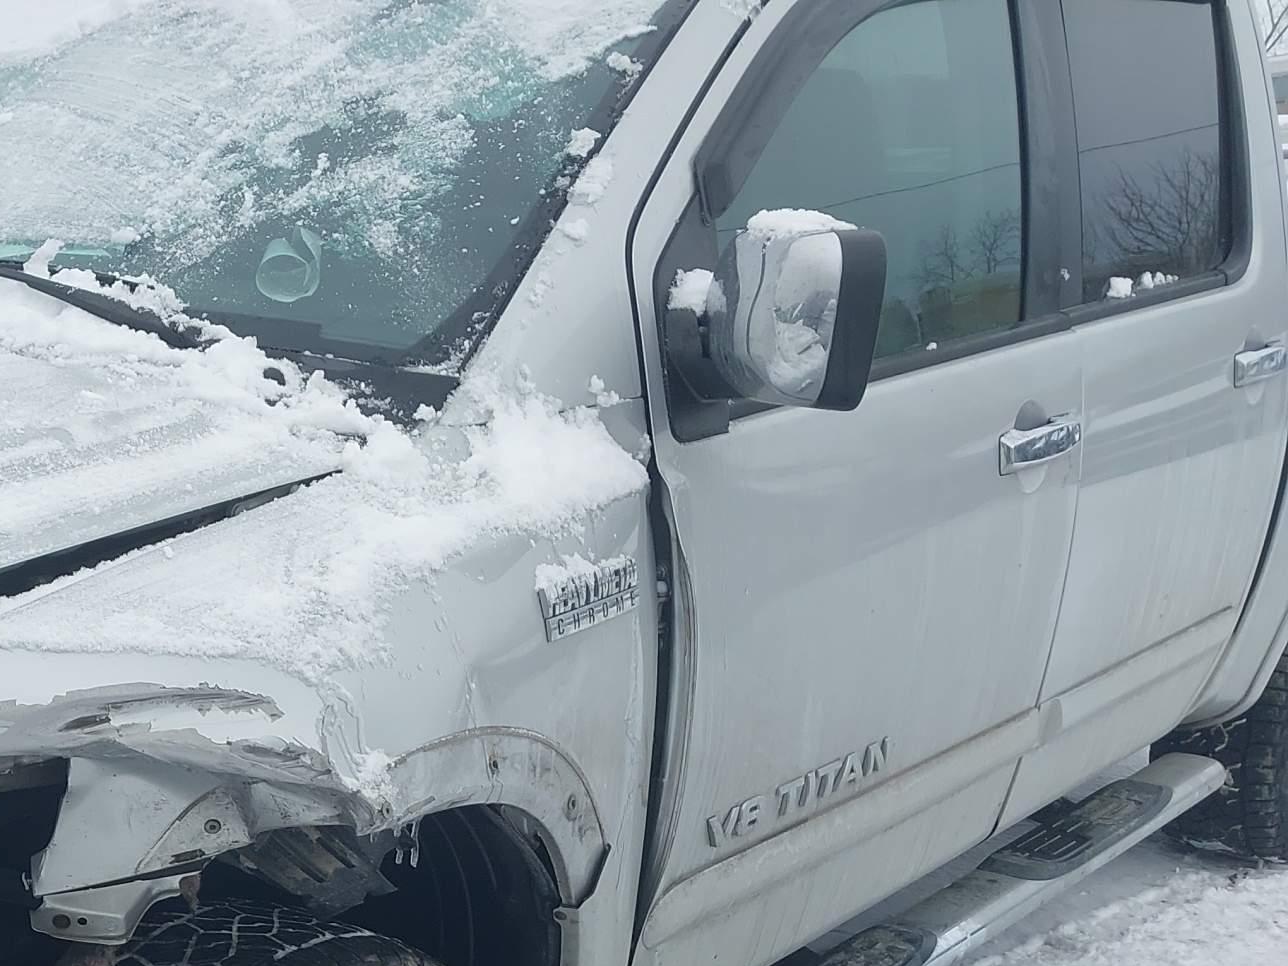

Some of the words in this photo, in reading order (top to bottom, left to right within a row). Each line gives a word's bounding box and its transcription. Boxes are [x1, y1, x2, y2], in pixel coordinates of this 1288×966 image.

[557, 591, 636, 636] CHROME
[706, 794, 765, 848] V8
[775, 735, 890, 817] TITAN
